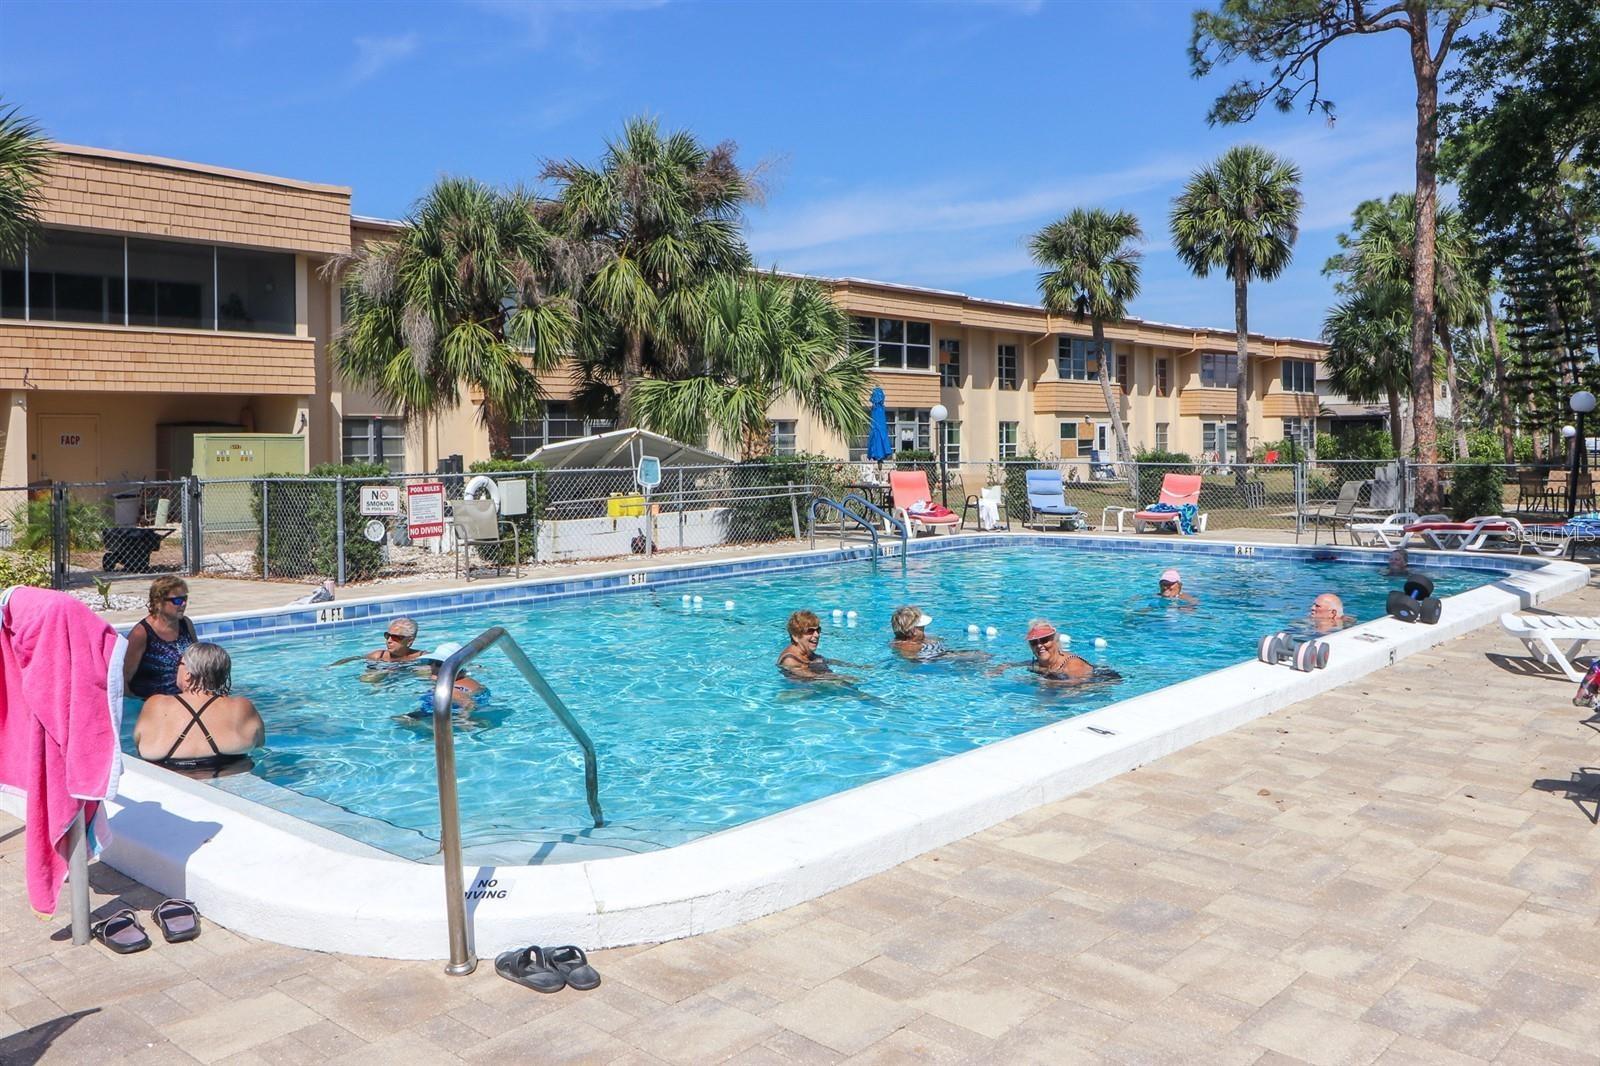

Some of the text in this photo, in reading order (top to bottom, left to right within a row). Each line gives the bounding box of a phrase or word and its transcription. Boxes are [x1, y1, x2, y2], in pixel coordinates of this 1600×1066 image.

[60, 435, 81, 445] FACP
[420, 526, 443, 534] DIVING
[631, 574, 636, 584] 5
[321, 609, 326, 622] 4
[477, 879, 498, 888] NO
